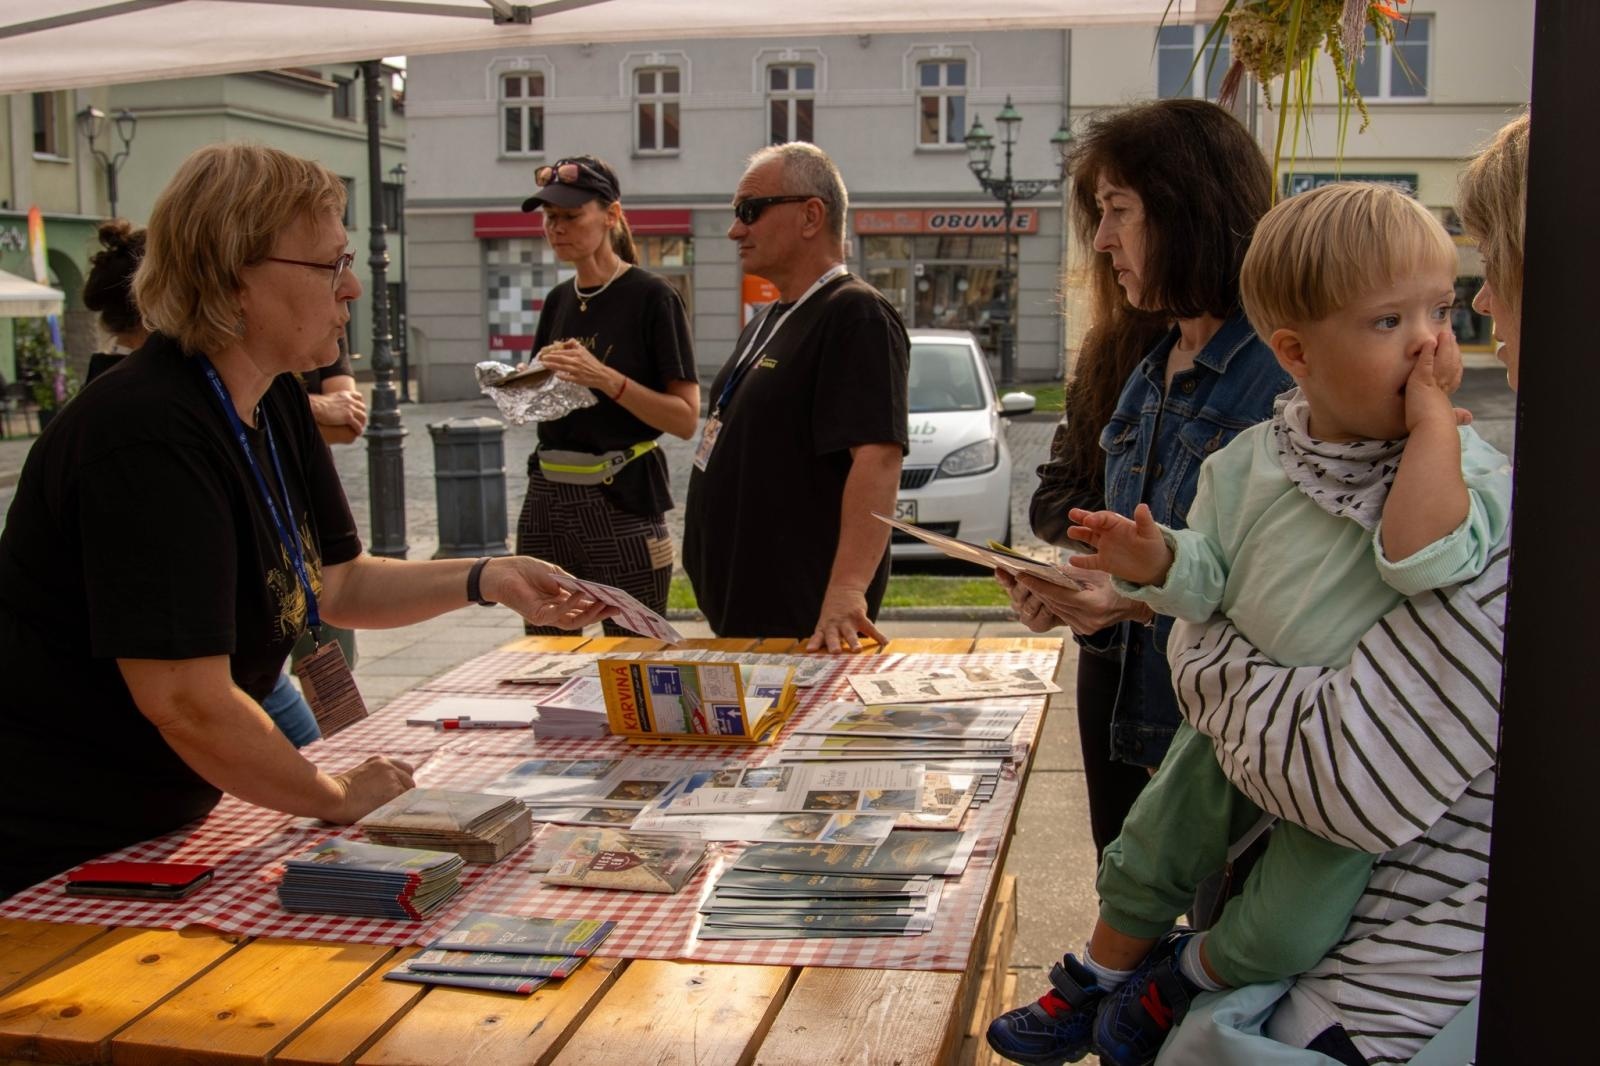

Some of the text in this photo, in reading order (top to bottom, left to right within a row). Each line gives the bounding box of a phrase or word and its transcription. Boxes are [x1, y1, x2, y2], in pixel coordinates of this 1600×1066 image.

[908, 420, 937, 435] ub
[896, 502, 914, 519] 54
[611, 665, 639, 731] KARVINÁ
